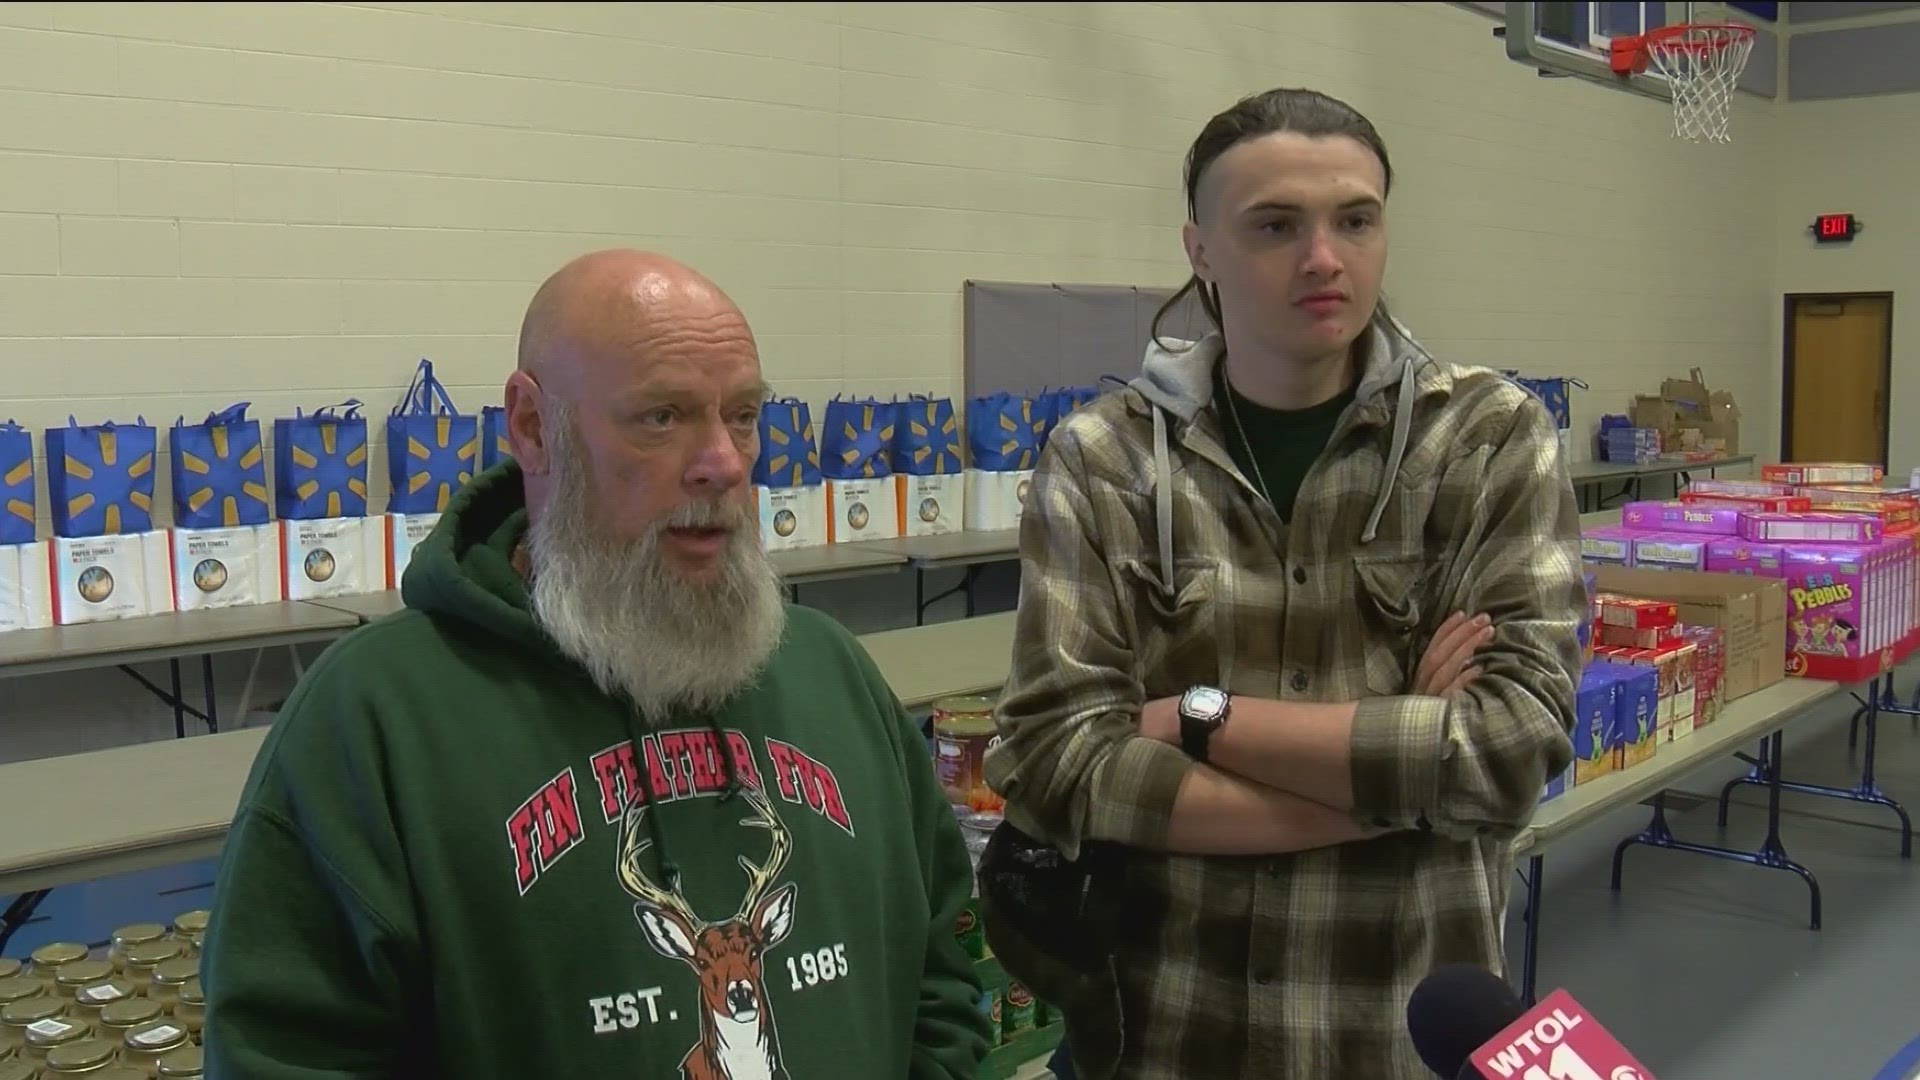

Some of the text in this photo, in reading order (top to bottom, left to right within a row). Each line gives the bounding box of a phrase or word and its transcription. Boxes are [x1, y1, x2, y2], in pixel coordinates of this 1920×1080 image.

[1823, 218, 1847, 235] EXIT
[1789, 583, 1853, 611] PEBBLES
[507, 766, 585, 897] FIN
[765, 736, 855, 838] FUR
[589, 943, 849, 1034] EST. 1985
[1487, 1008, 1582, 1078] WTOL
